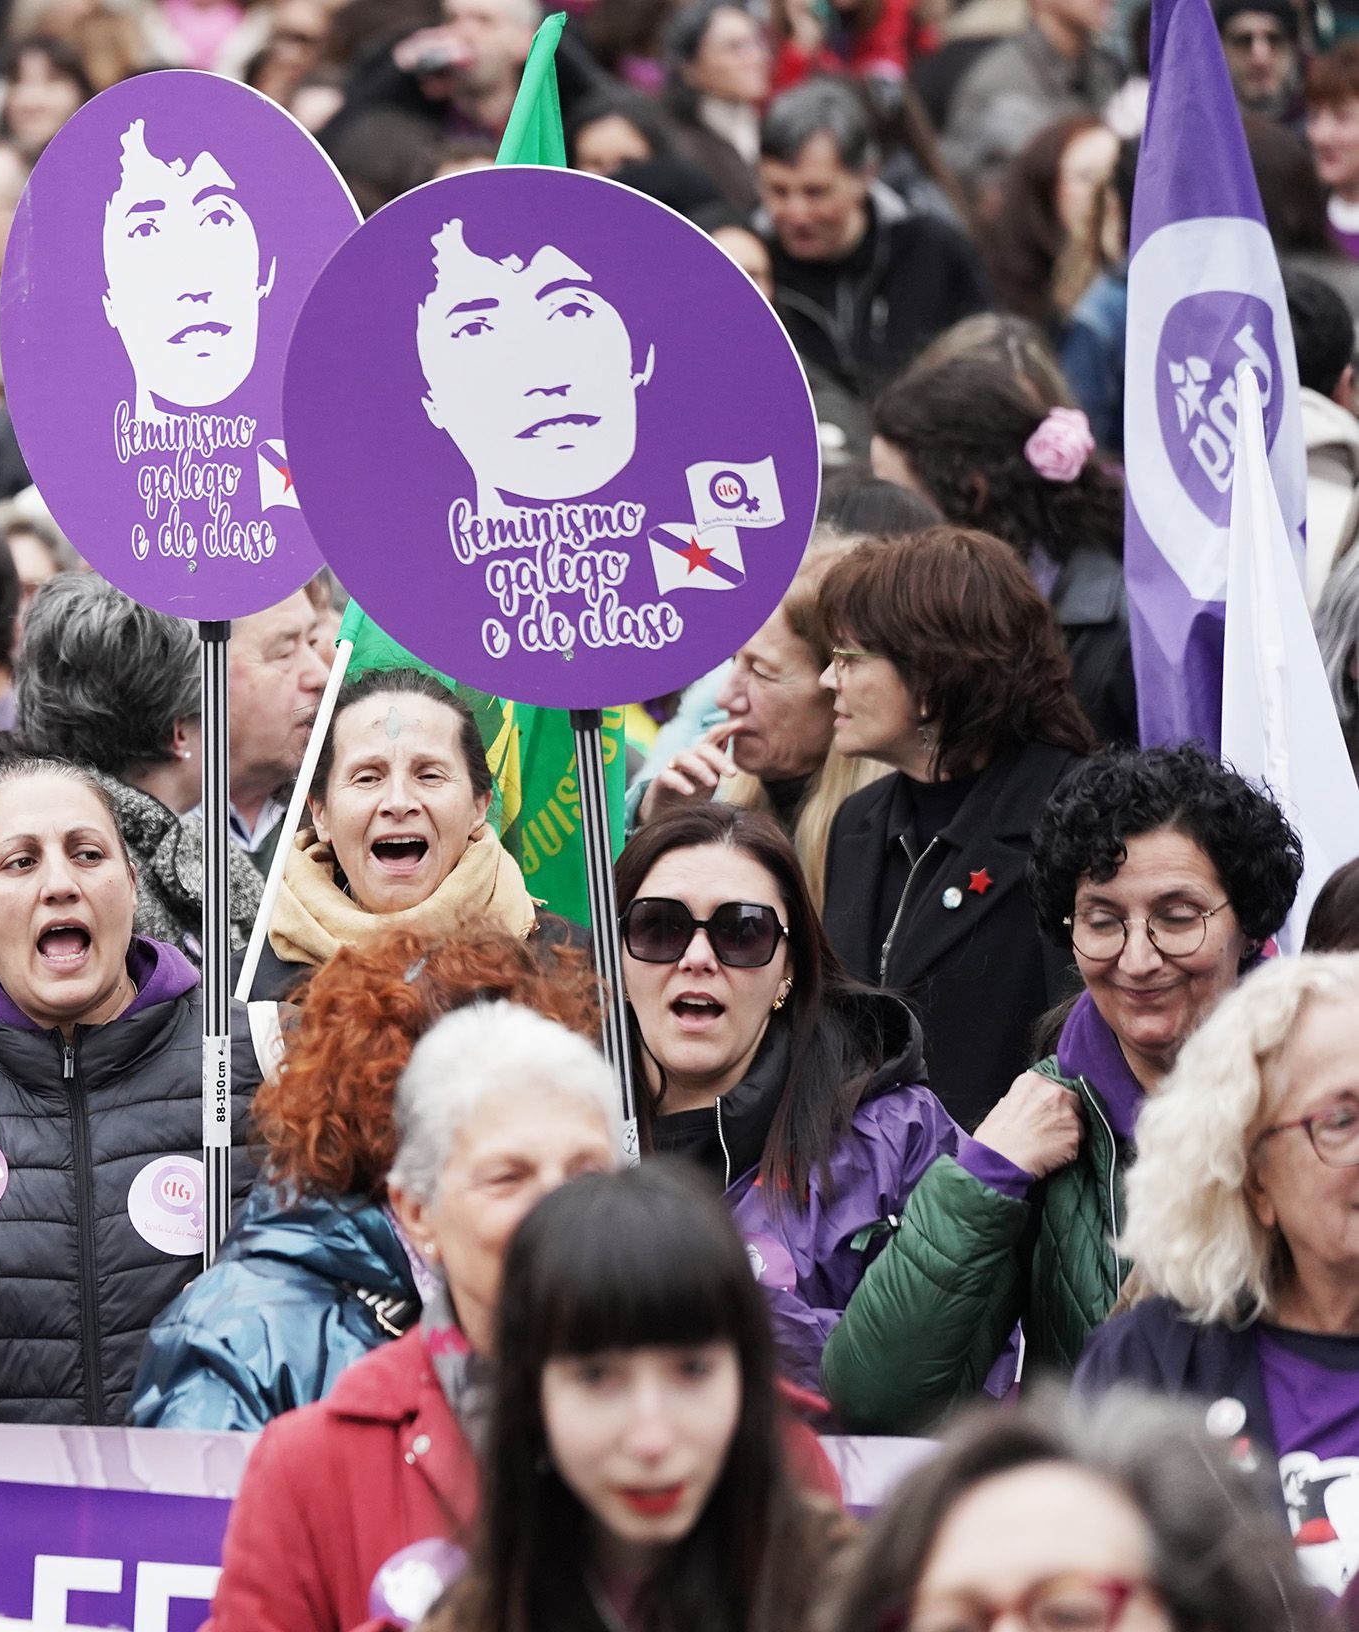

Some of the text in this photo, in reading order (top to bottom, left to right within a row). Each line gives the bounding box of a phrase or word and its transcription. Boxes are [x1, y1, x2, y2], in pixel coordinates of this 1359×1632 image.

[114, 400, 257, 463] feminismo
[138, 447, 242, 519] galego
[132, 502, 277, 563] e de clase
[448, 498, 646, 564] feminismo
[485, 543, 630, 617] galego
[482, 588, 683, 659] e de clase
[218, 1061, 226, 1078] cm
[216, 1080, 226, 1123] 88-150
[163, 1181, 191, 1201] CIG
